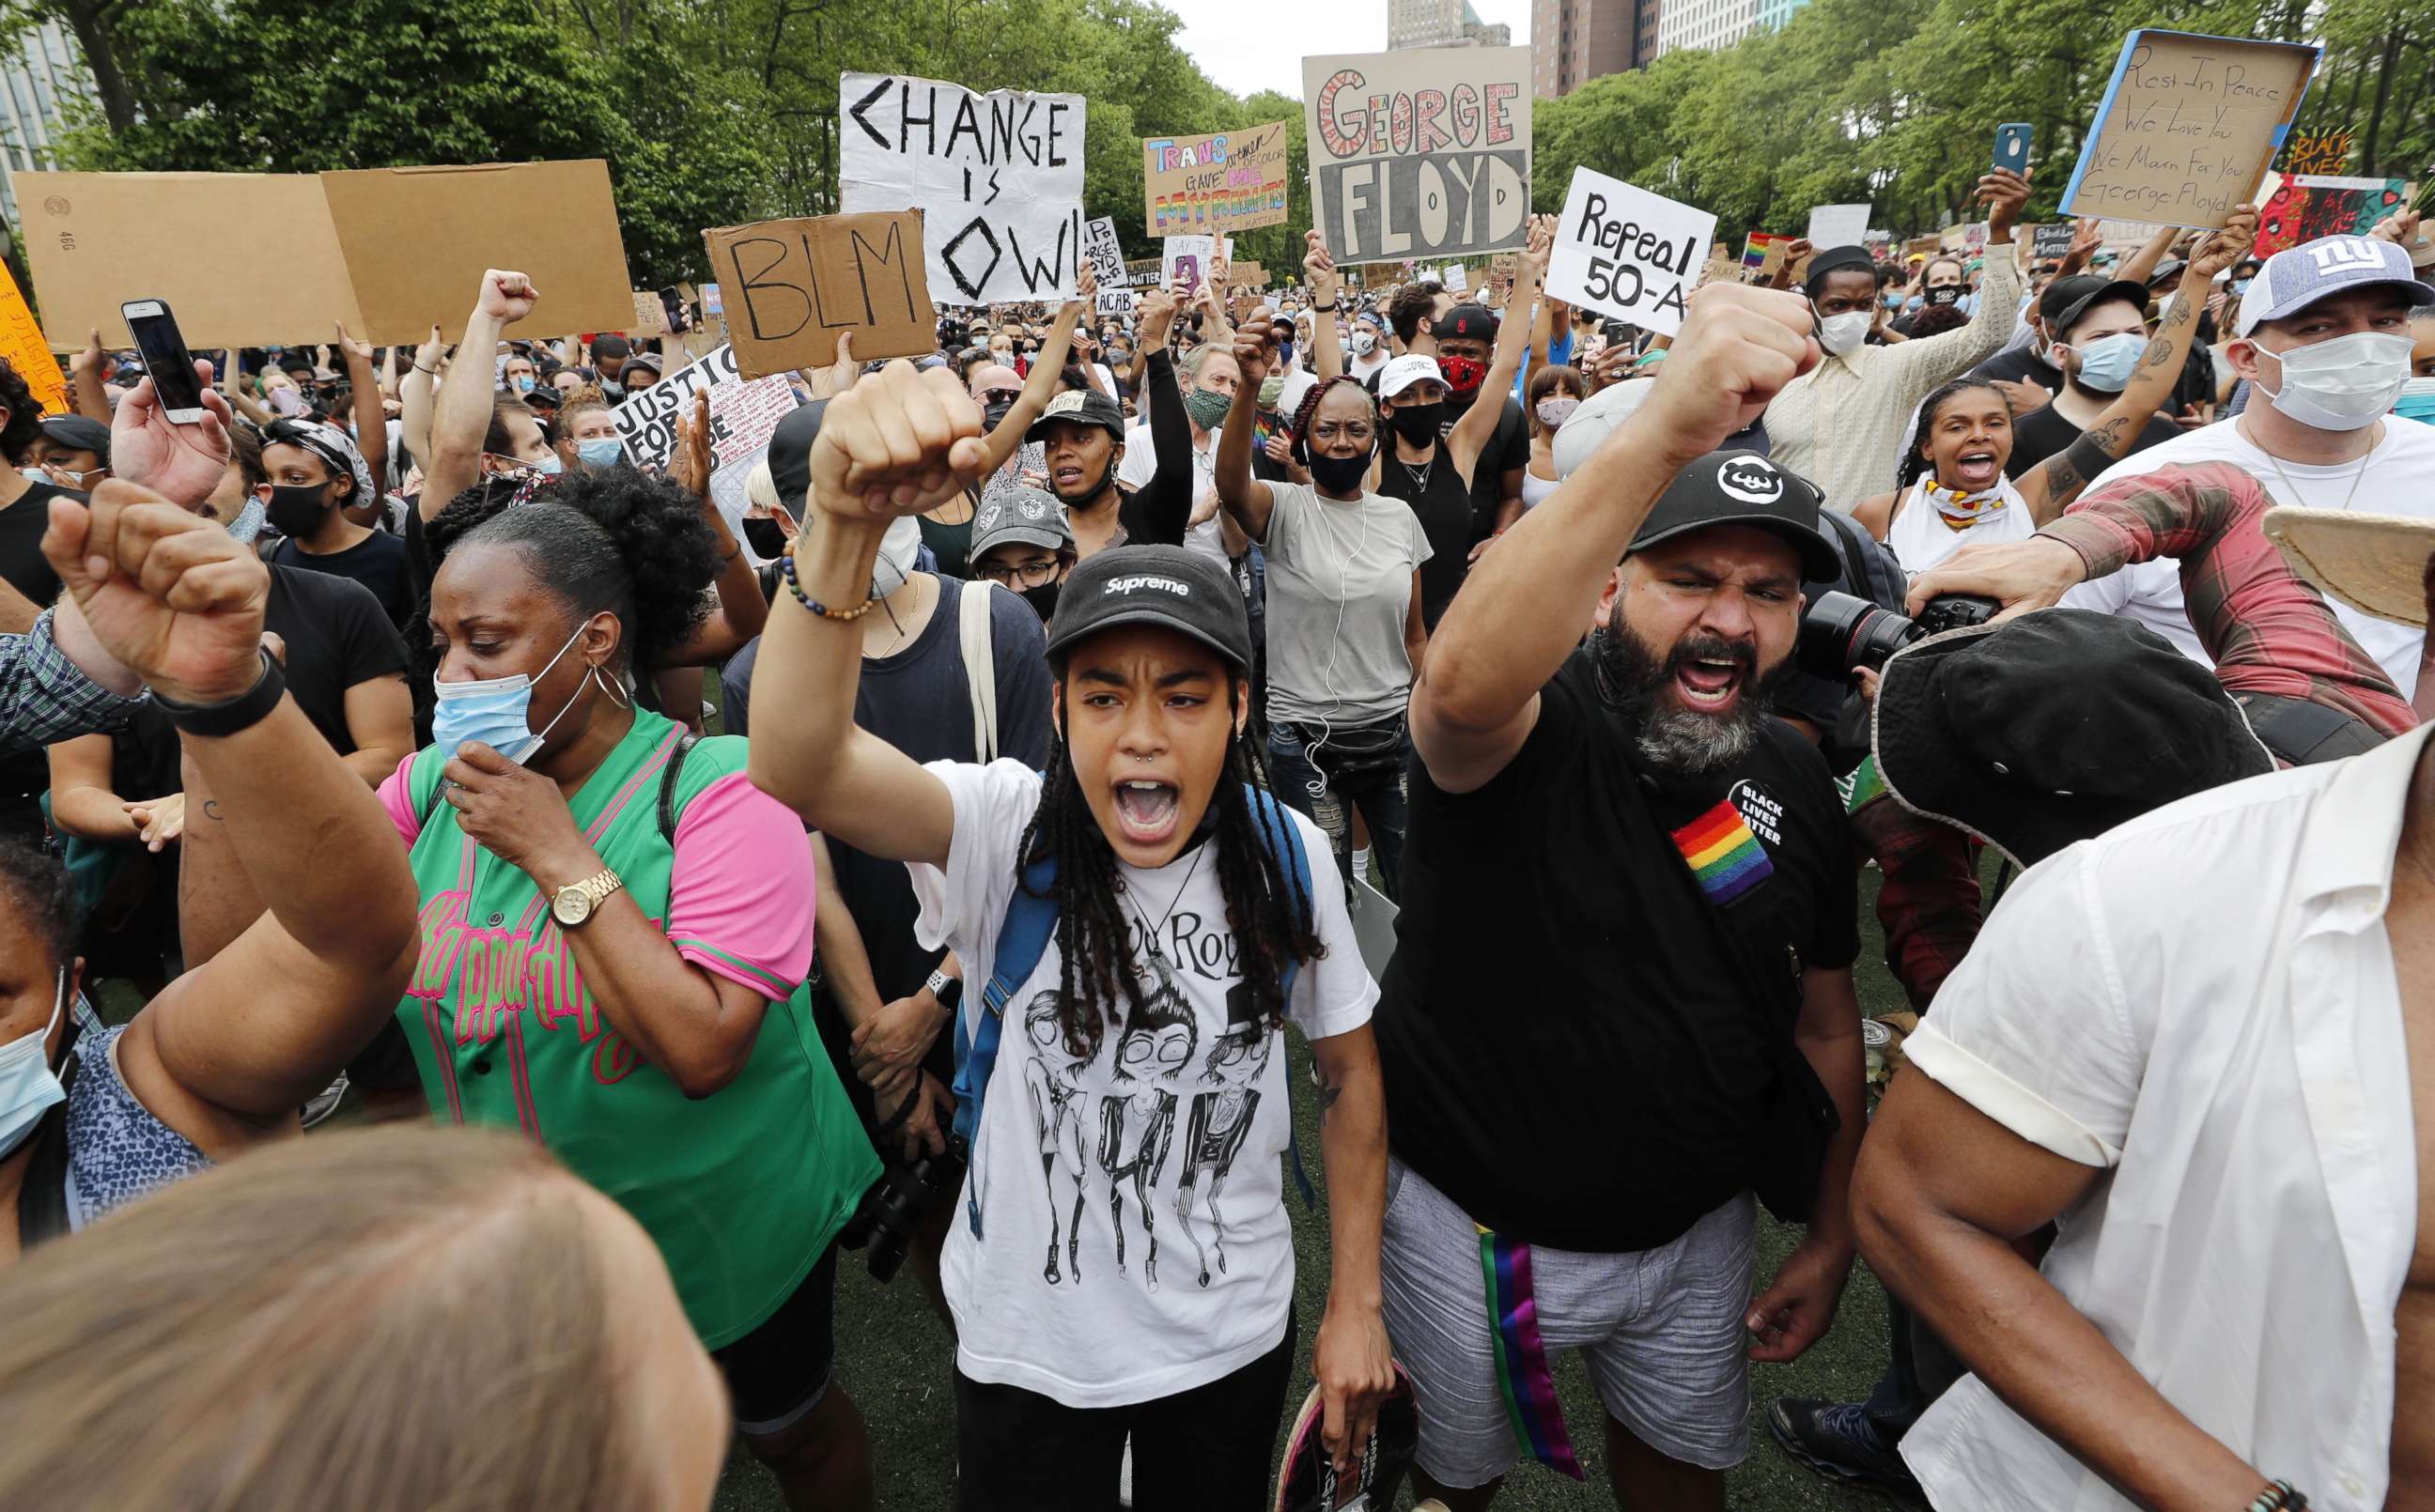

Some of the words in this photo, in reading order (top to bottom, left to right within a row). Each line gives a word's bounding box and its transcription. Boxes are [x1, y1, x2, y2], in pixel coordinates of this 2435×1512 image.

[2122, 45, 2177, 88] Rest
[2185, 56, 2215, 92] In
[2224, 65, 2279, 100] Peace
[848, 77, 1069, 167] CHANGE
[1317, 69, 1518, 158] GEORGE
[2125, 95, 2159, 131] We
[2167, 98, 2201, 136] Love
[2210, 105, 2232, 139] You
[1149, 135, 1228, 174] TRANS
[1258, 148, 1285, 164] COLOR
[2091, 135, 2120, 171] We
[2188, 147, 2214, 177] For
[2217, 155, 2243, 182] You
[2288, 157, 2347, 176] LIVES
[2293, 133, 2352, 163] BLACK
[1186, 171, 1220, 191] GAVE
[1228, 165, 1264, 187] ME
[2078, 169, 2172, 211] George
[2177, 182, 2228, 218] Floyd
[1156, 192, 1210, 227] MY
[1212, 179, 1286, 221] RIGHTS
[1341, 154, 1524, 256] FLOYD
[941, 208, 1078, 301] OW!
[1172, 239, 1190, 254] SAY
[1196, 240, 1212, 255] THE
[1576, 193, 1697, 276] Repeal
[730, 221, 917, 340] BLM
[1099, 293, 1131, 312] ACAB
[1584, 256, 1684, 322] 50-A
[616, 347, 737, 435] JUSTIC
[1105, 577, 1188, 596] Supreme
[1742, 785, 1783, 817] BLACK
[1742, 800, 1777, 827] LIVES
[406, 890, 532, 1045] Kappa
